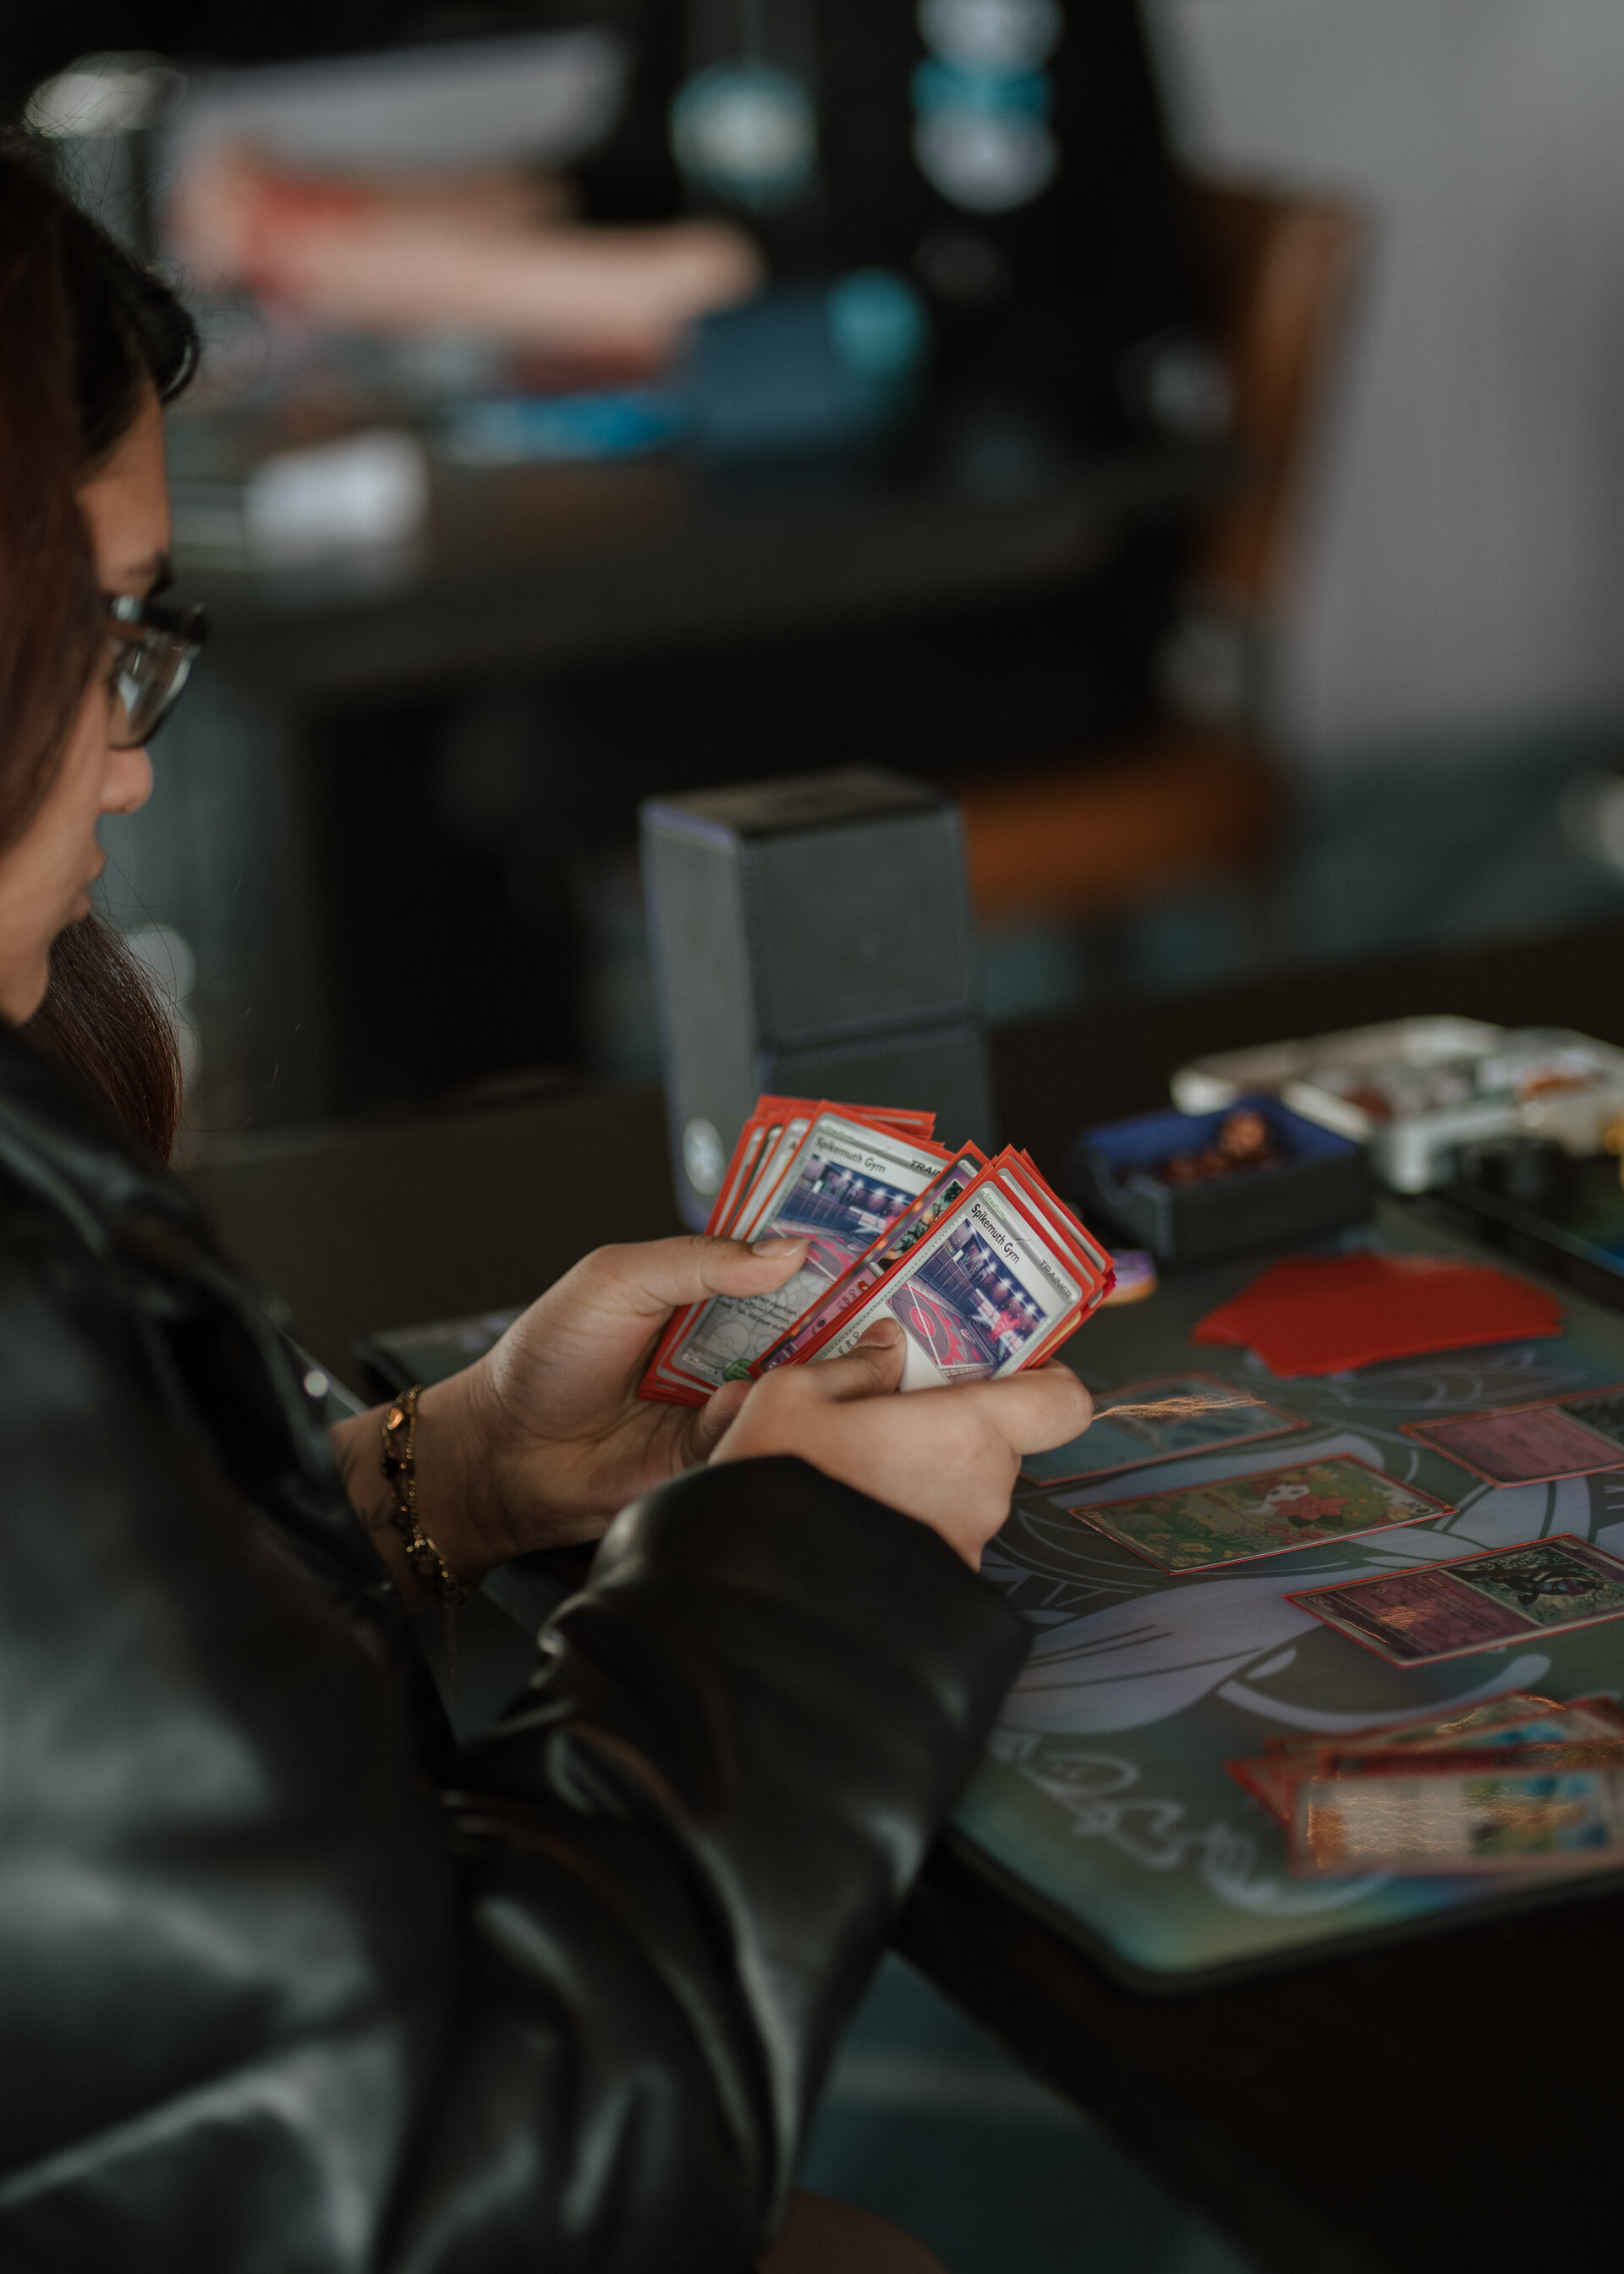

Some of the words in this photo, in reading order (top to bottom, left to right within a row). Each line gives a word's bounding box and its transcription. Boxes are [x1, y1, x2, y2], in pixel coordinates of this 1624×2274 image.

[815, 1136, 863, 1164] Spikemuth
[864, 1156, 886, 1173] Gym
[983, 1193, 1006, 1220] Stadium
[972, 1203, 1006, 1245] Spikemuth
[1004, 1243, 1020, 1264] Gym
[1040, 1259, 1072, 1299] TRAINER
